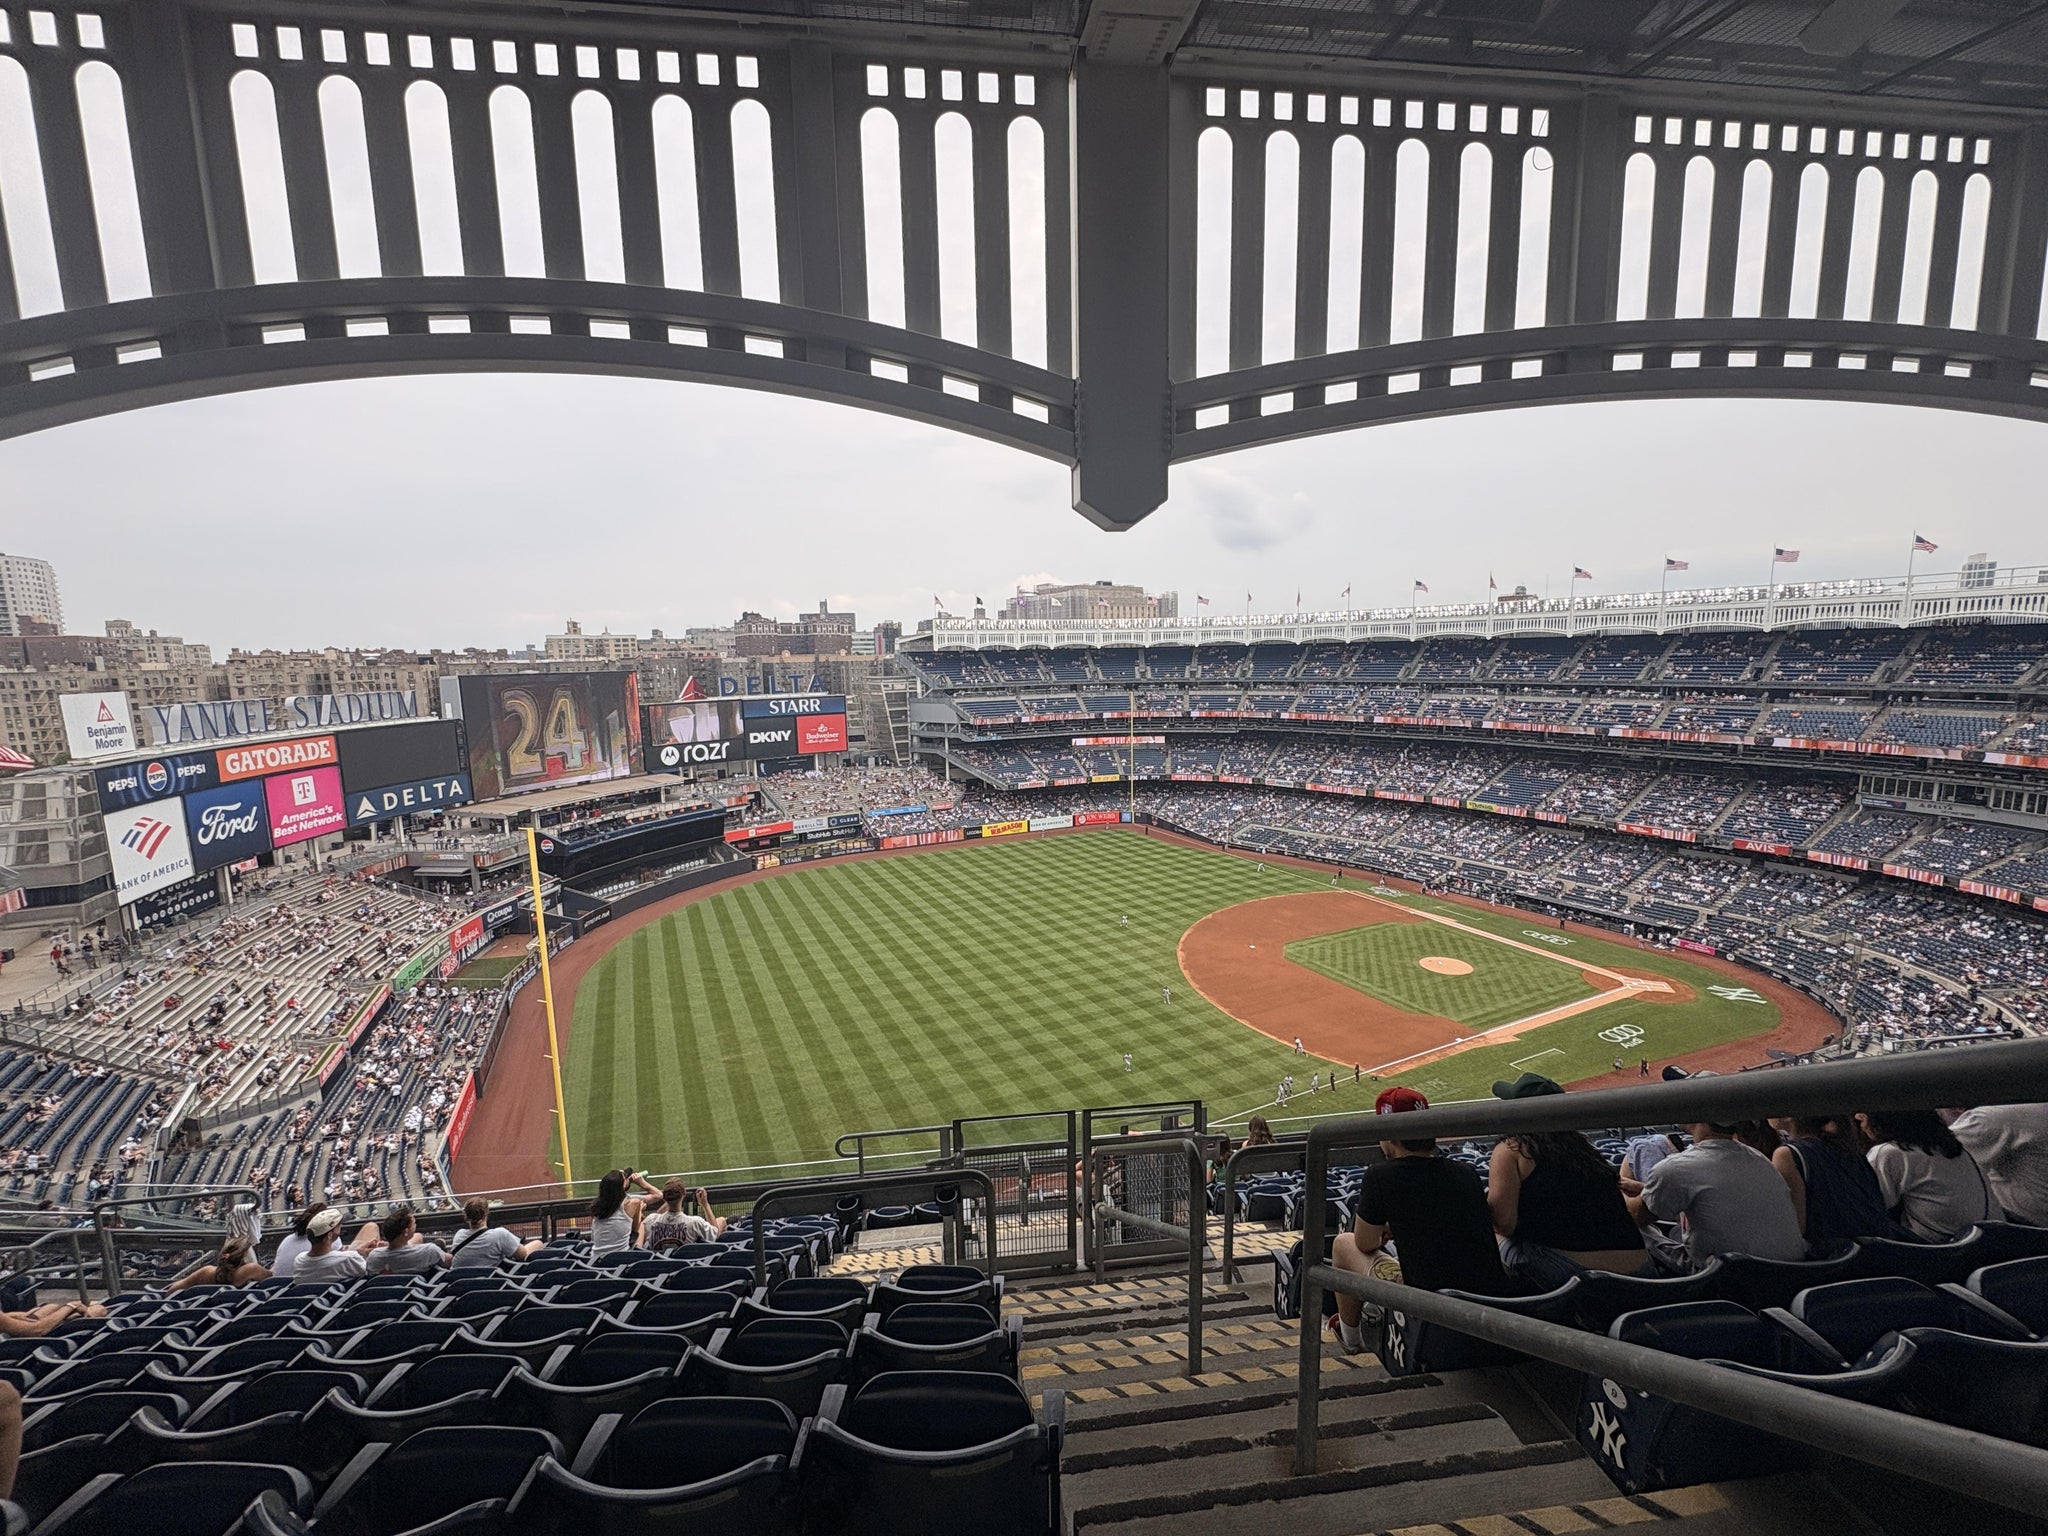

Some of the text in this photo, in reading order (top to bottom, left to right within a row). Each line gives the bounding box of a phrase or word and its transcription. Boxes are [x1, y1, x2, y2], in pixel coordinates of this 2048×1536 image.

[719, 674, 828, 697] DELTA
[769, 698, 821, 715] STARR
[154, 690, 418, 744] YANKEE STADIUM
[87, 723, 127, 738] Benjamin
[502, 687, 589, 776] 24
[750, 730, 792, 744] DKNY
[805, 732, 839, 740] Budweiser
[95, 737, 123, 750] Moore
[225, 740, 331, 774] GATORADE
[683, 742, 730, 763] razr
[149, 772, 166, 782] PEPSI
[177, 764, 206, 777] PEPSI
[107, 776, 137, 792] PEPSI
[297, 781, 310, 799] T
[383, 780, 463, 811] DELTA
[280, 804, 334, 825] America's
[1927, 803, 1953, 811] DELTA
[198, 802, 258, 845] Ford
[273, 812, 343, 838] Best Network
[807, 831, 831, 840] StubHub
[1746, 843, 1775, 853] AVIS
[116, 858, 190, 892] BANK OF AMERICA
[494, 905, 513, 918] coupa
[1588, 1402, 1627, 1470] NY
